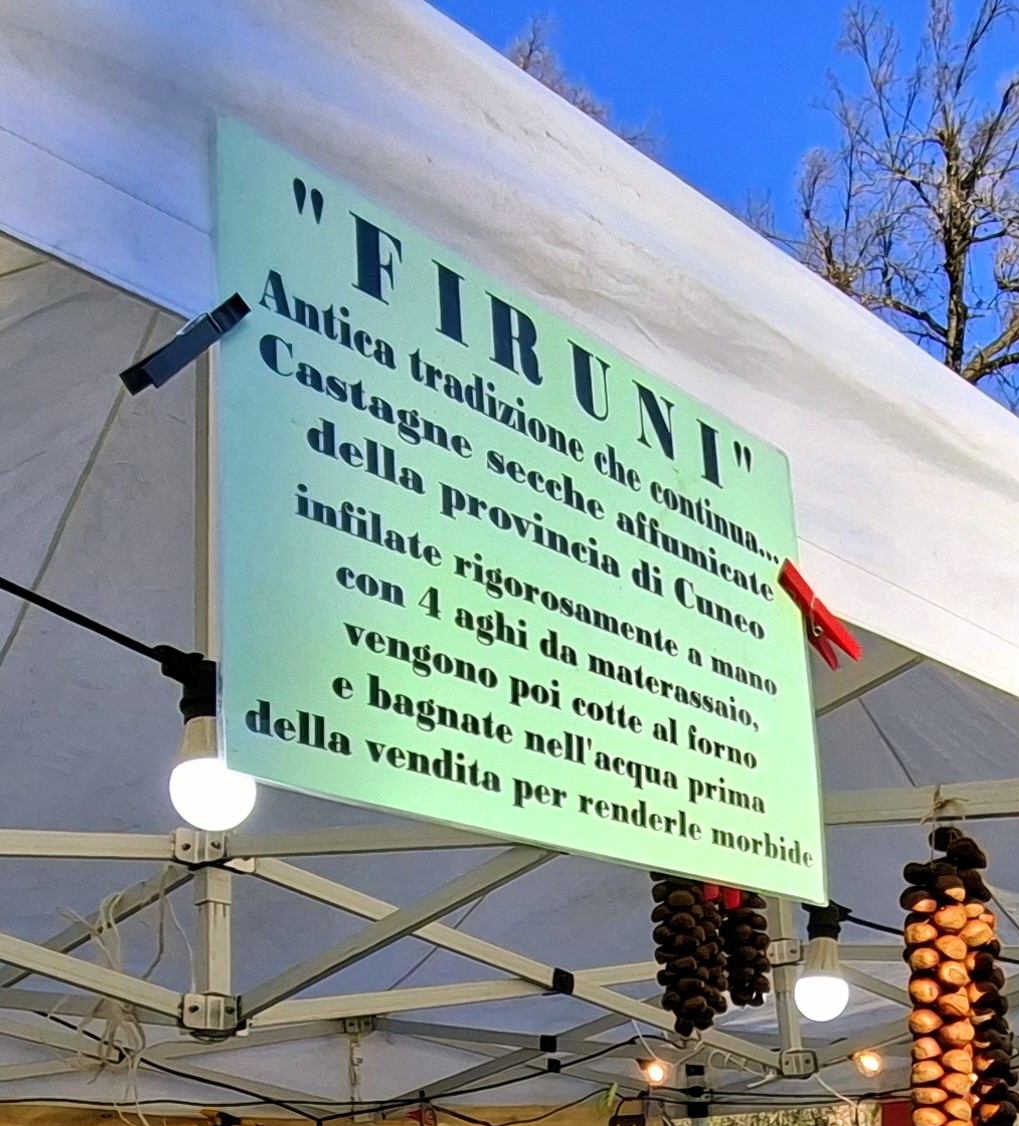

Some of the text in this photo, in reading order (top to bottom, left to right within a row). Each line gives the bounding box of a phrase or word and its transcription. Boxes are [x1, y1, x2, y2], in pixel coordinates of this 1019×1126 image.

[258, 268, 780, 565] Antica tradizione che continua...
[259, 333, 775, 602] Castagne secche affumicate
[294, 482, 779, 697] infilate rigorosamente a mano
[306, 417, 767, 641] della provincia di Cuneo
[332, 672, 767, 815] e bagnate nell'acqua prima
[336, 565, 761, 733] con 4 aghi da materassaio,
[343, 621, 759, 771] vengono poi cotte al forno
[244, 698, 814, 870] della vendita per renderle morbide
